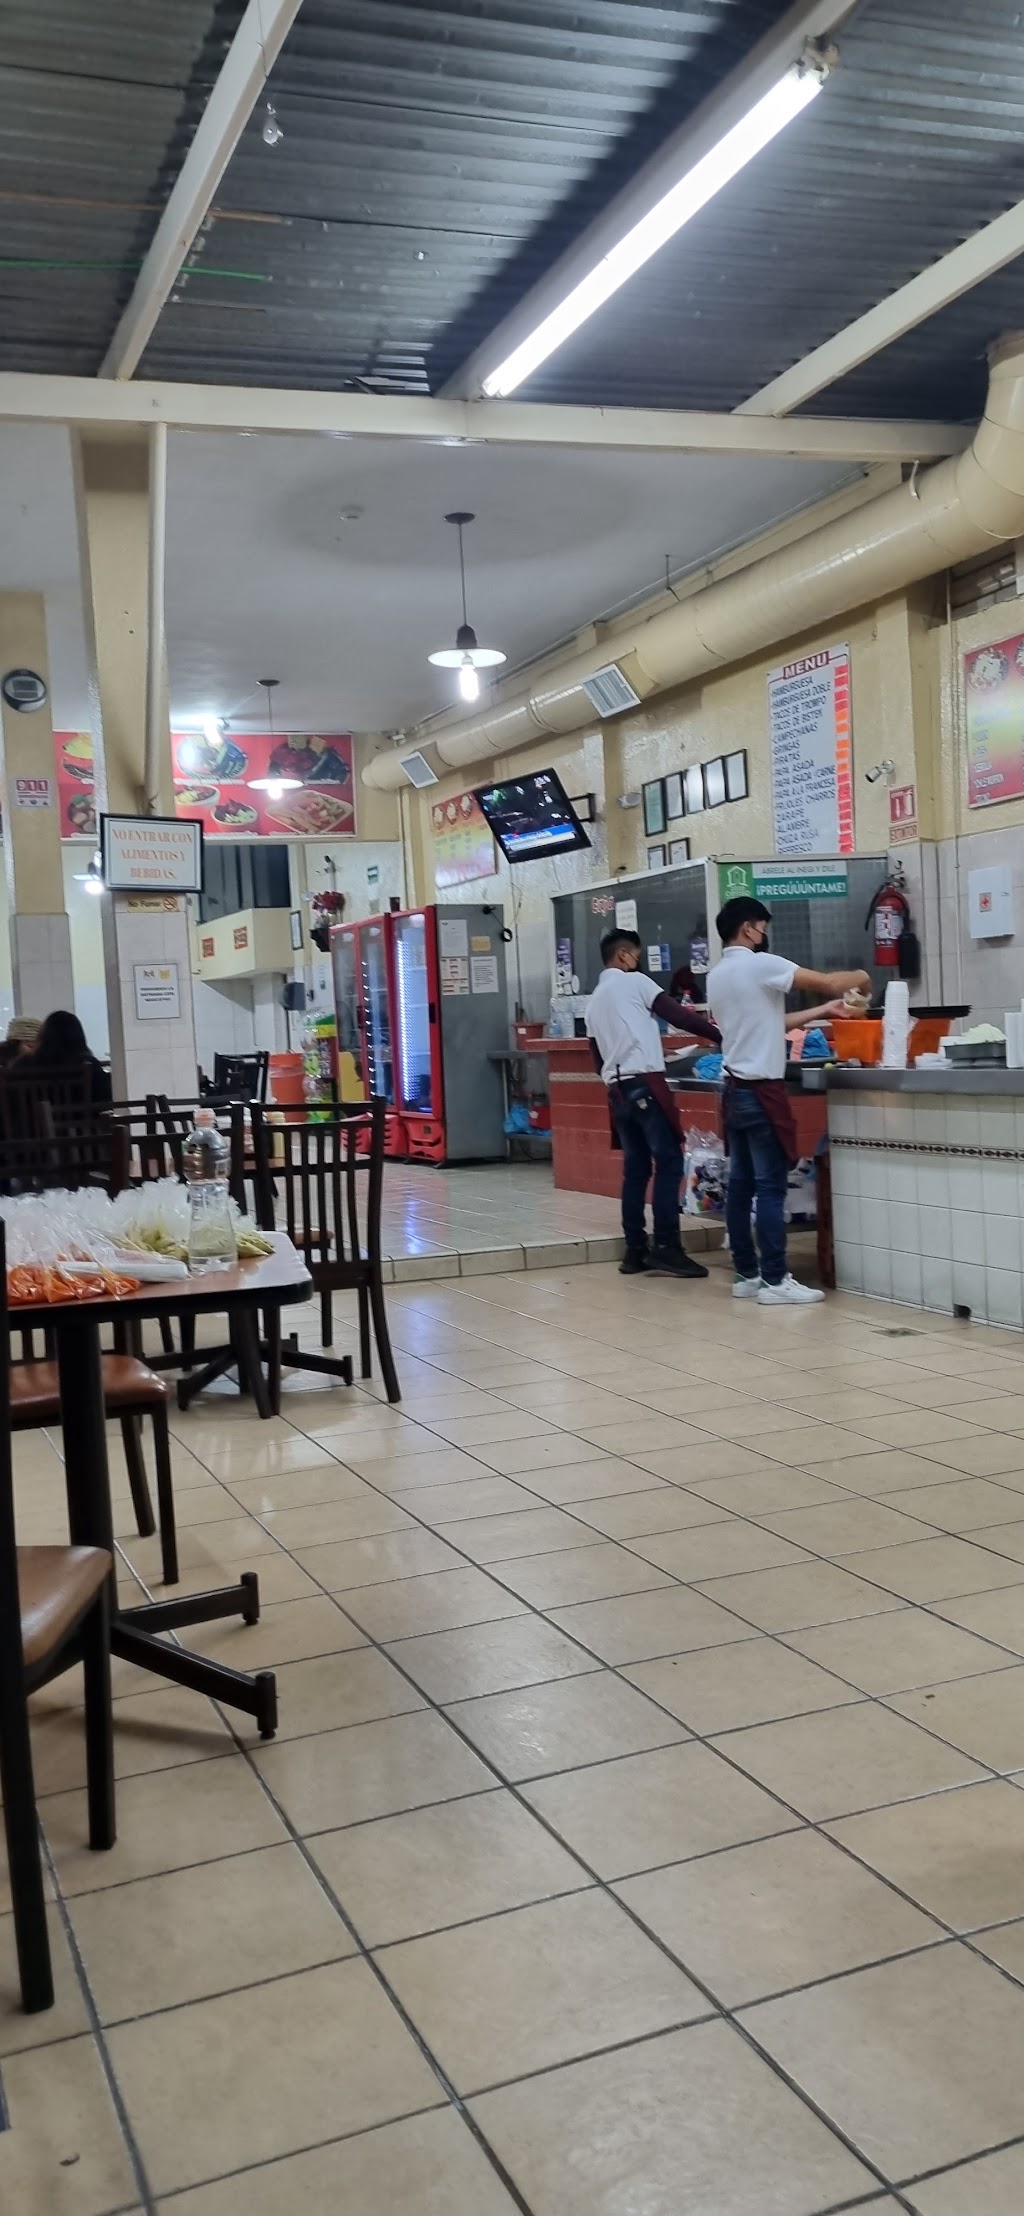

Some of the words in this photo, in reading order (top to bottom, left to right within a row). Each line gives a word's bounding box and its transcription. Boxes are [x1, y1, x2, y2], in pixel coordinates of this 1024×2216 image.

[784, 652, 828, 678] MENU
[17, 780, 47, 790] 911
[112, 828, 126, 841] NO
[127, 830, 170, 842] ENTRAR
[171, 832, 192, 844] CON
[121, 848, 178, 861] ALIMENTOS
[128, 900, 138, 908] No
